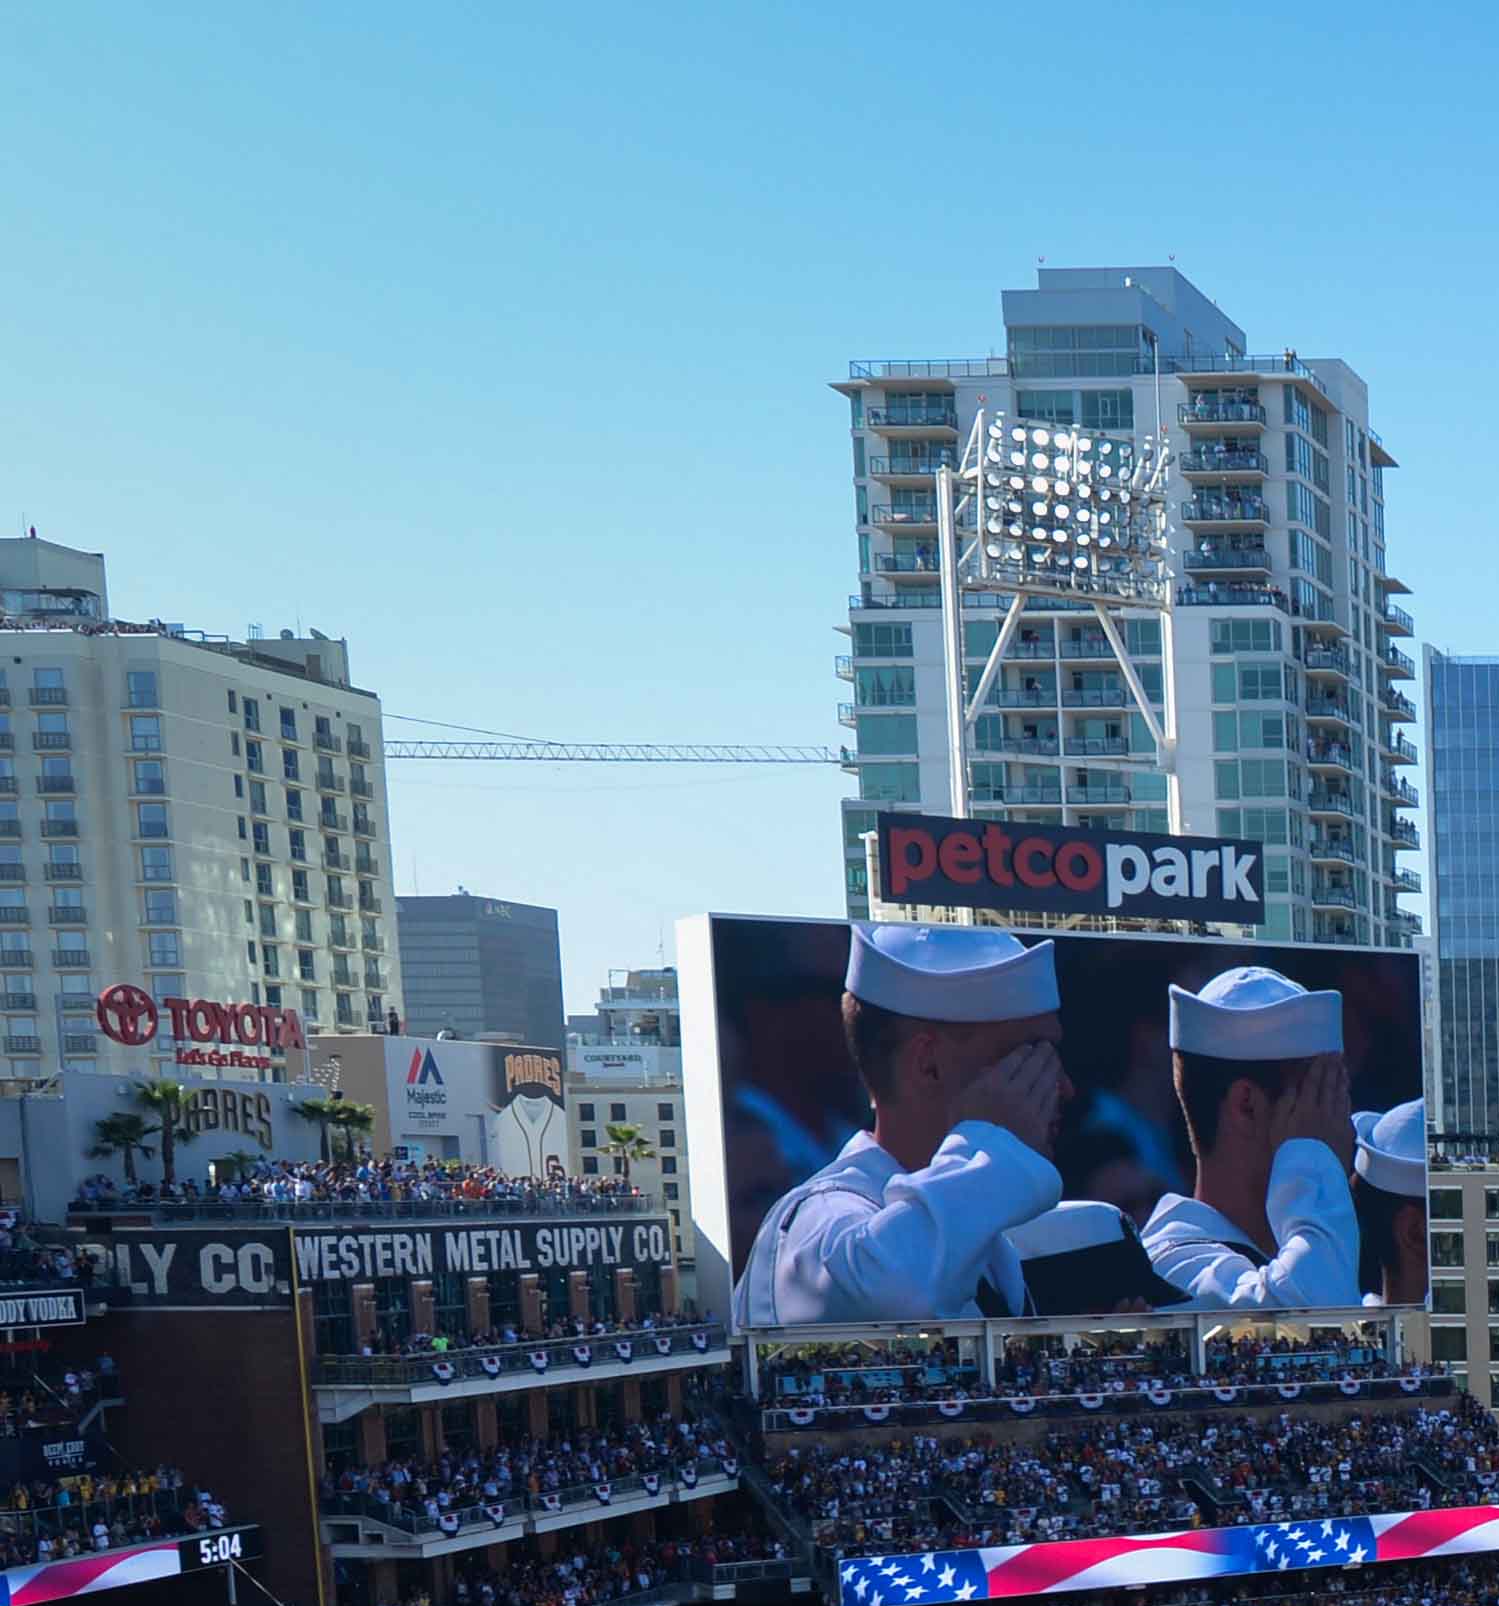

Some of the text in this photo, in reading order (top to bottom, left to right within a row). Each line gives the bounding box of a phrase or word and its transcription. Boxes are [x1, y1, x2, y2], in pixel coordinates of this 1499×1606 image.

[163, 997, 305, 1050] TOYOTA
[505, 1053, 561, 1096] PADRES
[407, 1088, 447, 1108] Majestic
[200, 1242, 291, 1294] CO.
[295, 1225, 671, 1281] WESTERN METAL SUPPLY CO.
[30, 1295, 77, 1321] VODKA
[200, 1533, 242, 1564] 5:04
